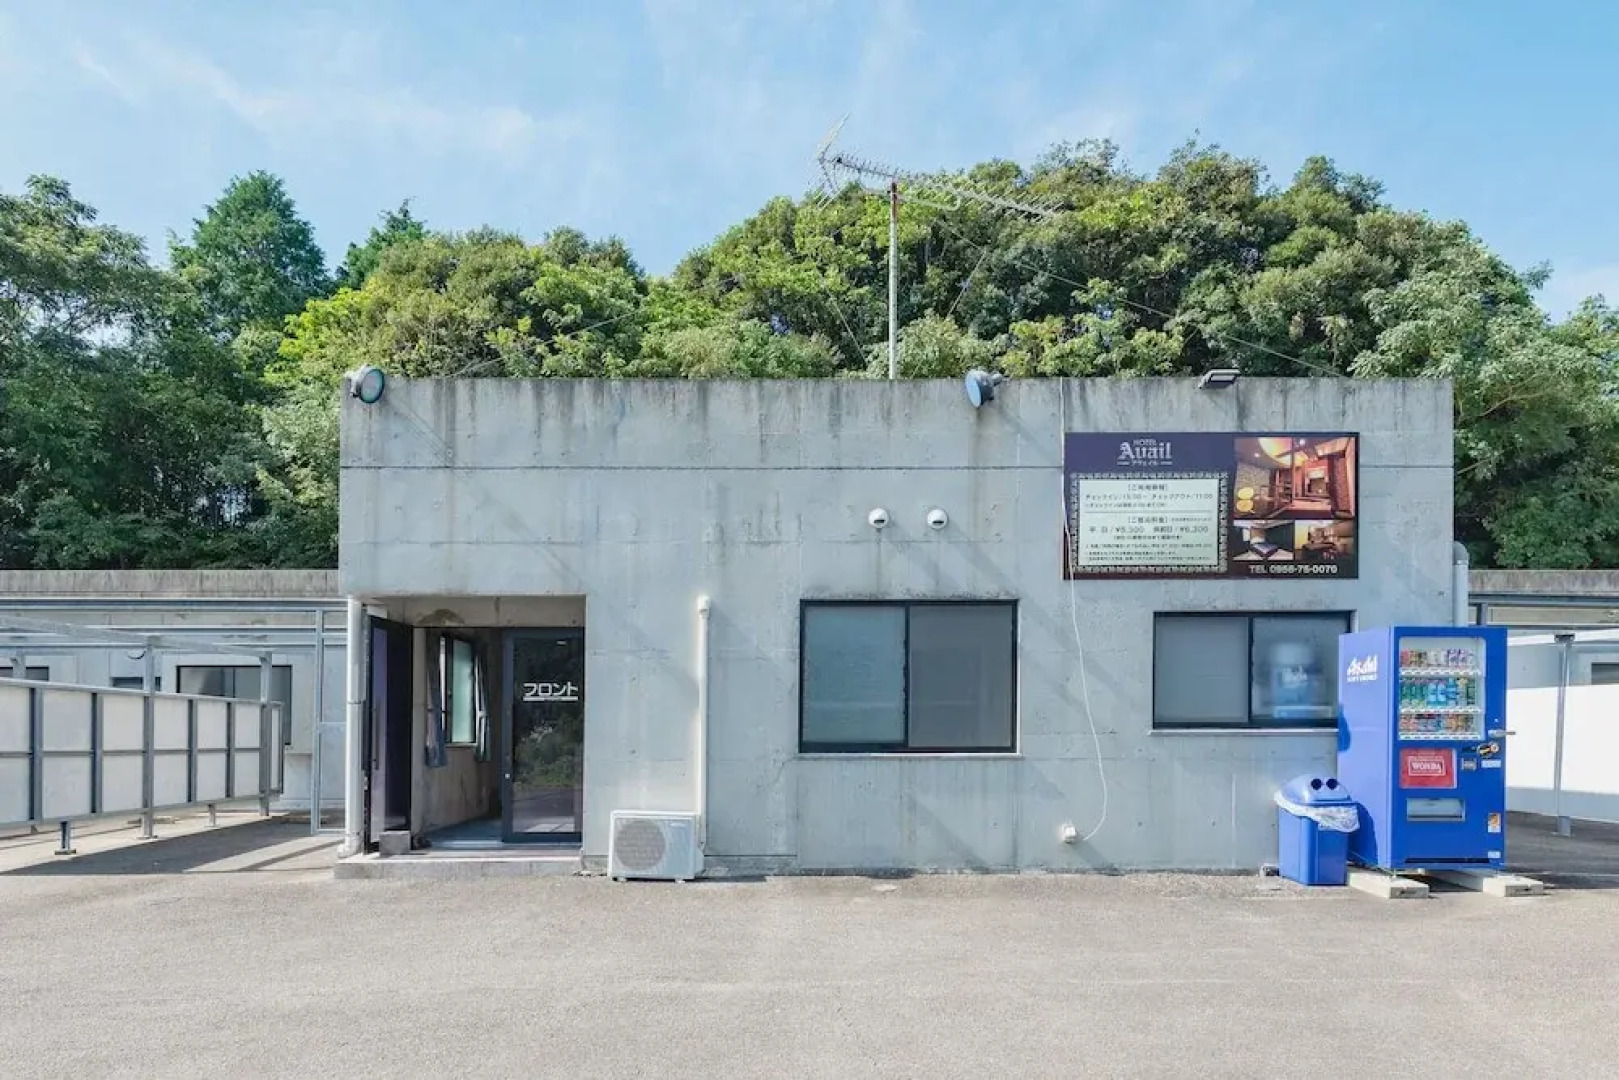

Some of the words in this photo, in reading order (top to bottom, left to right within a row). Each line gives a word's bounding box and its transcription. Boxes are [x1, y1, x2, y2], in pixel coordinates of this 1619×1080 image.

[1249, 565, 1267, 574] TEL
[523, 681, 578, 697] フロント
